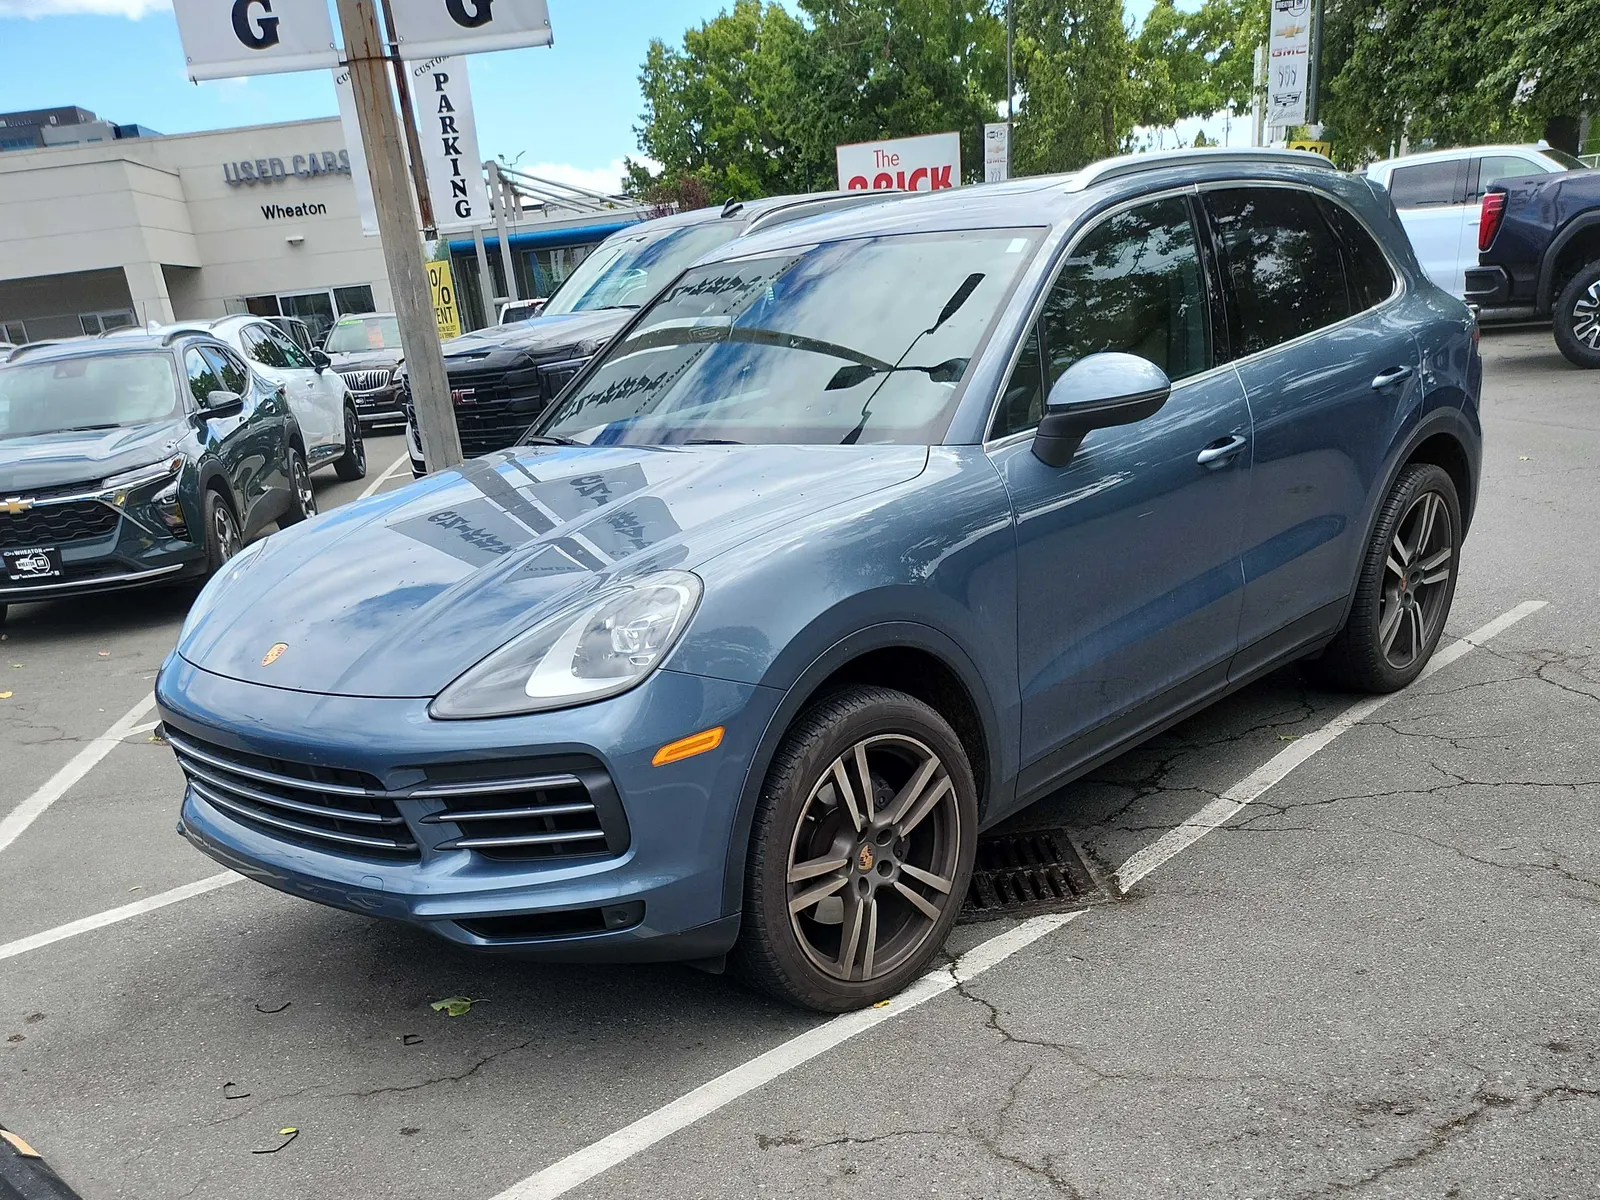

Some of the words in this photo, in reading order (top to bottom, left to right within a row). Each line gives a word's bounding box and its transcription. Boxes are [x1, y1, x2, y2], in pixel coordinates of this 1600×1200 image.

[1271, 44, 1307, 57] GMC
[433, 72, 472, 219] PARKING
[222, 159, 287, 187] USED
[292, 149, 352, 180] CARS
[873, 149, 900, 168] The
[260, 202, 327, 220] Wheaton
[434, 306, 454, 325] ENT
[14, 547, 43, 556] WHEATON
